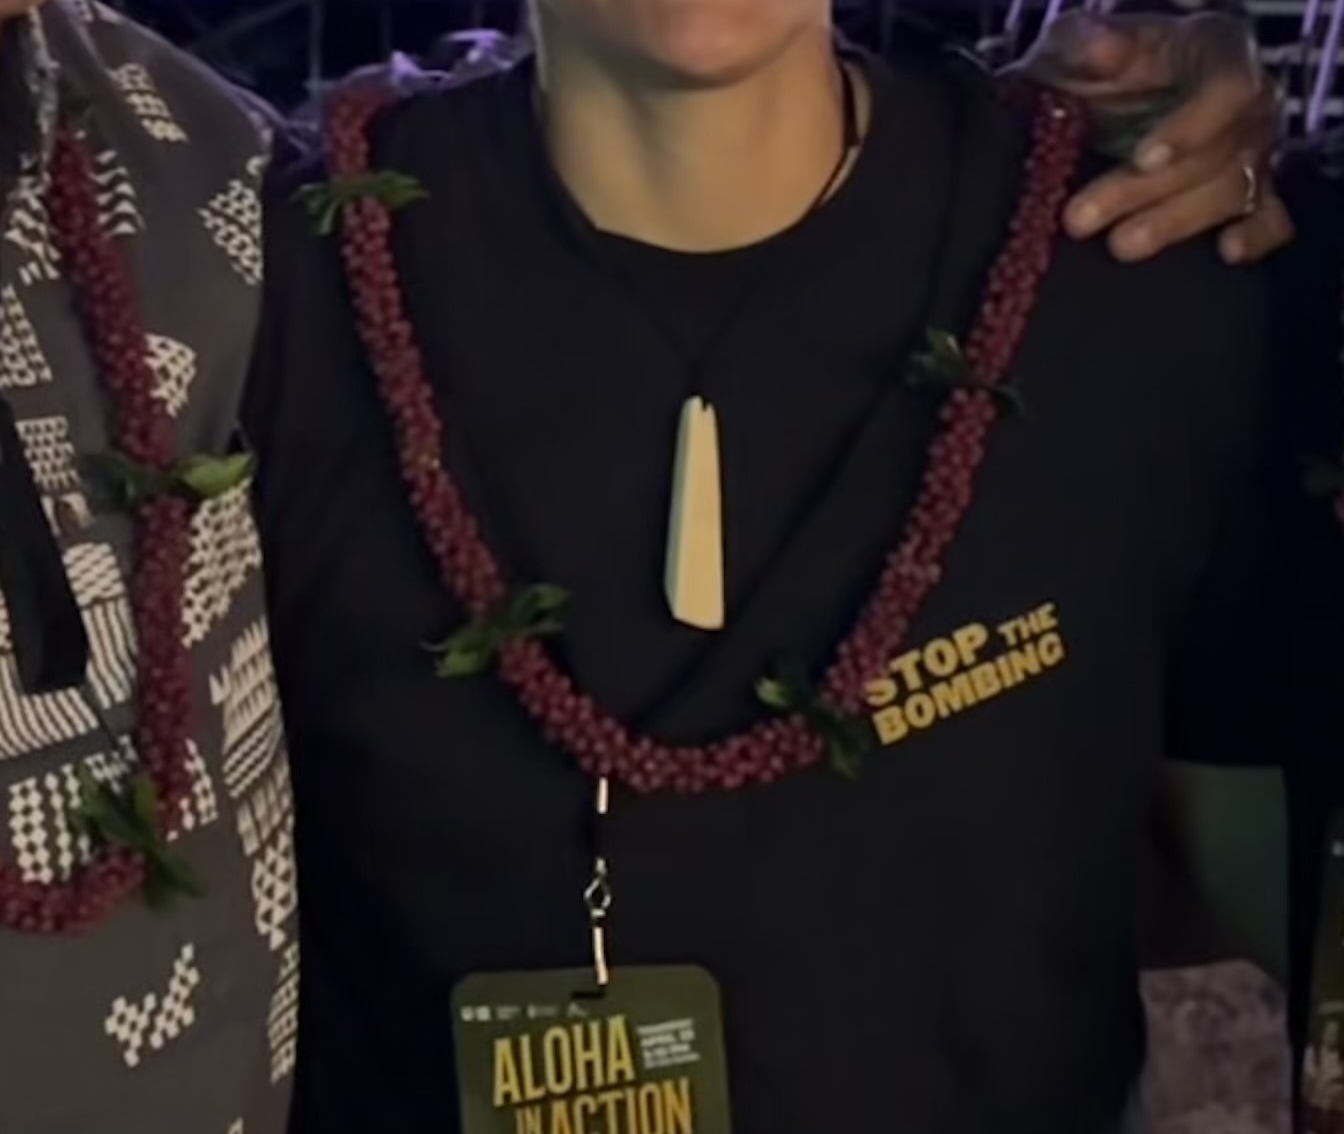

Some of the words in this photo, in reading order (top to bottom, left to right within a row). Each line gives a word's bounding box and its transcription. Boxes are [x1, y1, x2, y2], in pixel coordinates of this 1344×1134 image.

[864, 623, 988, 706] STOP
[997, 602, 1058, 645] THE
[872, 632, 1065, 745] BOMBING
[493, 1015, 636, 1107] ALOHA
